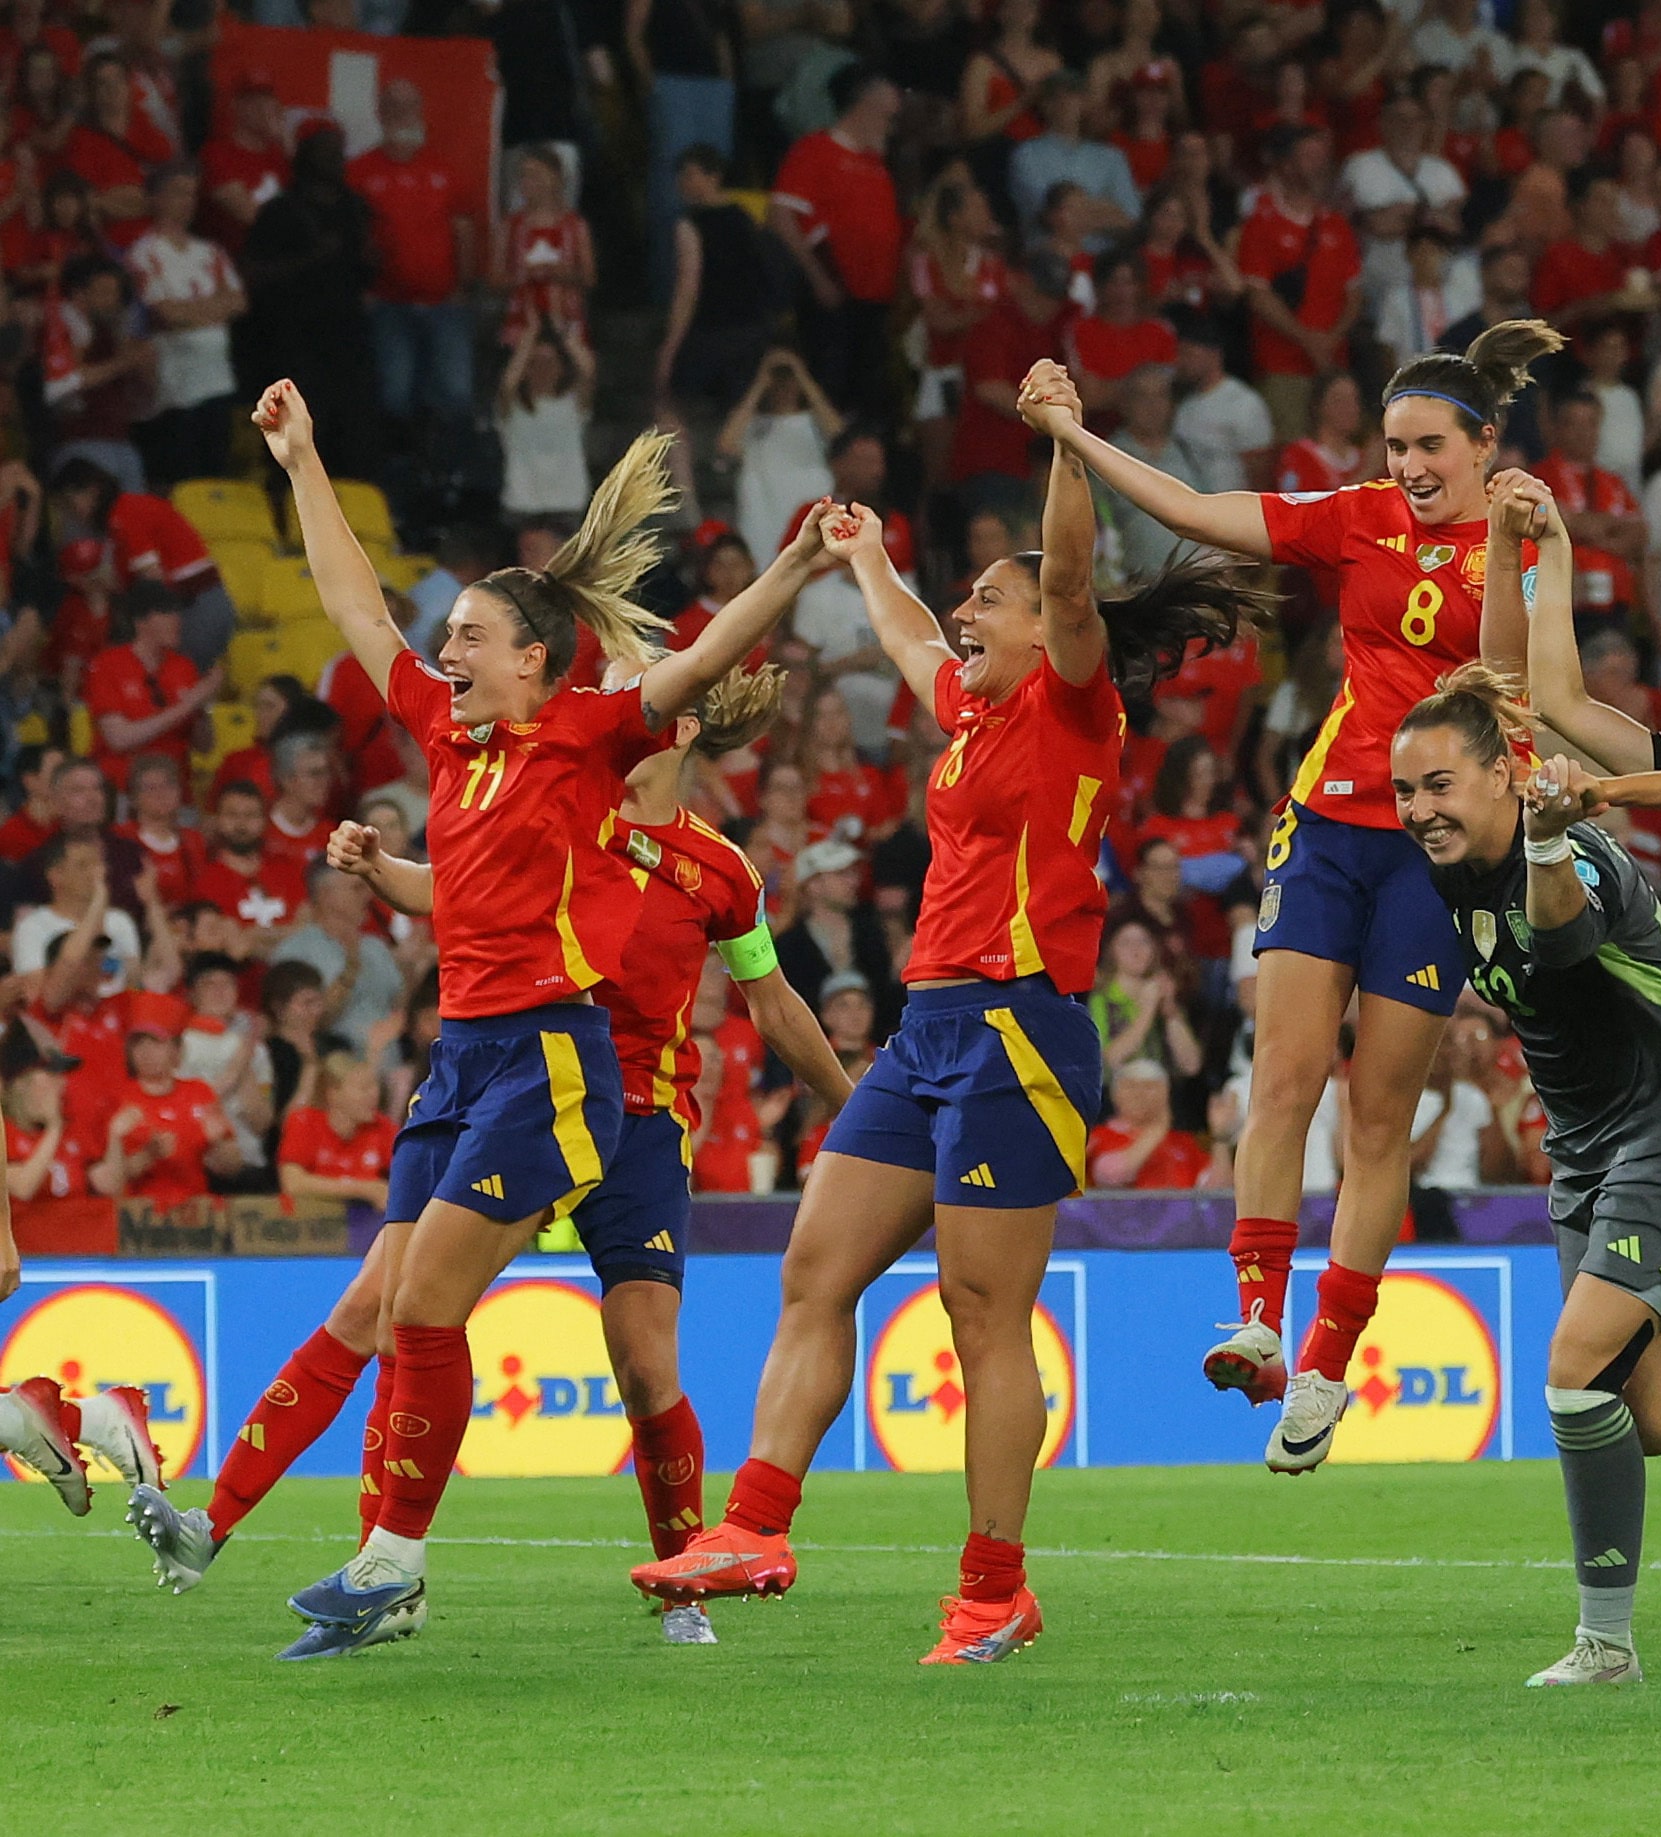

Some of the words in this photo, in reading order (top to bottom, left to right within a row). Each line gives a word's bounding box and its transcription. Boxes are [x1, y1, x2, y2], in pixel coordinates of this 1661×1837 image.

[1400, 579, 1445, 646] 8
[459, 748, 506, 811] 11
[1266, 800, 1299, 871] 8
